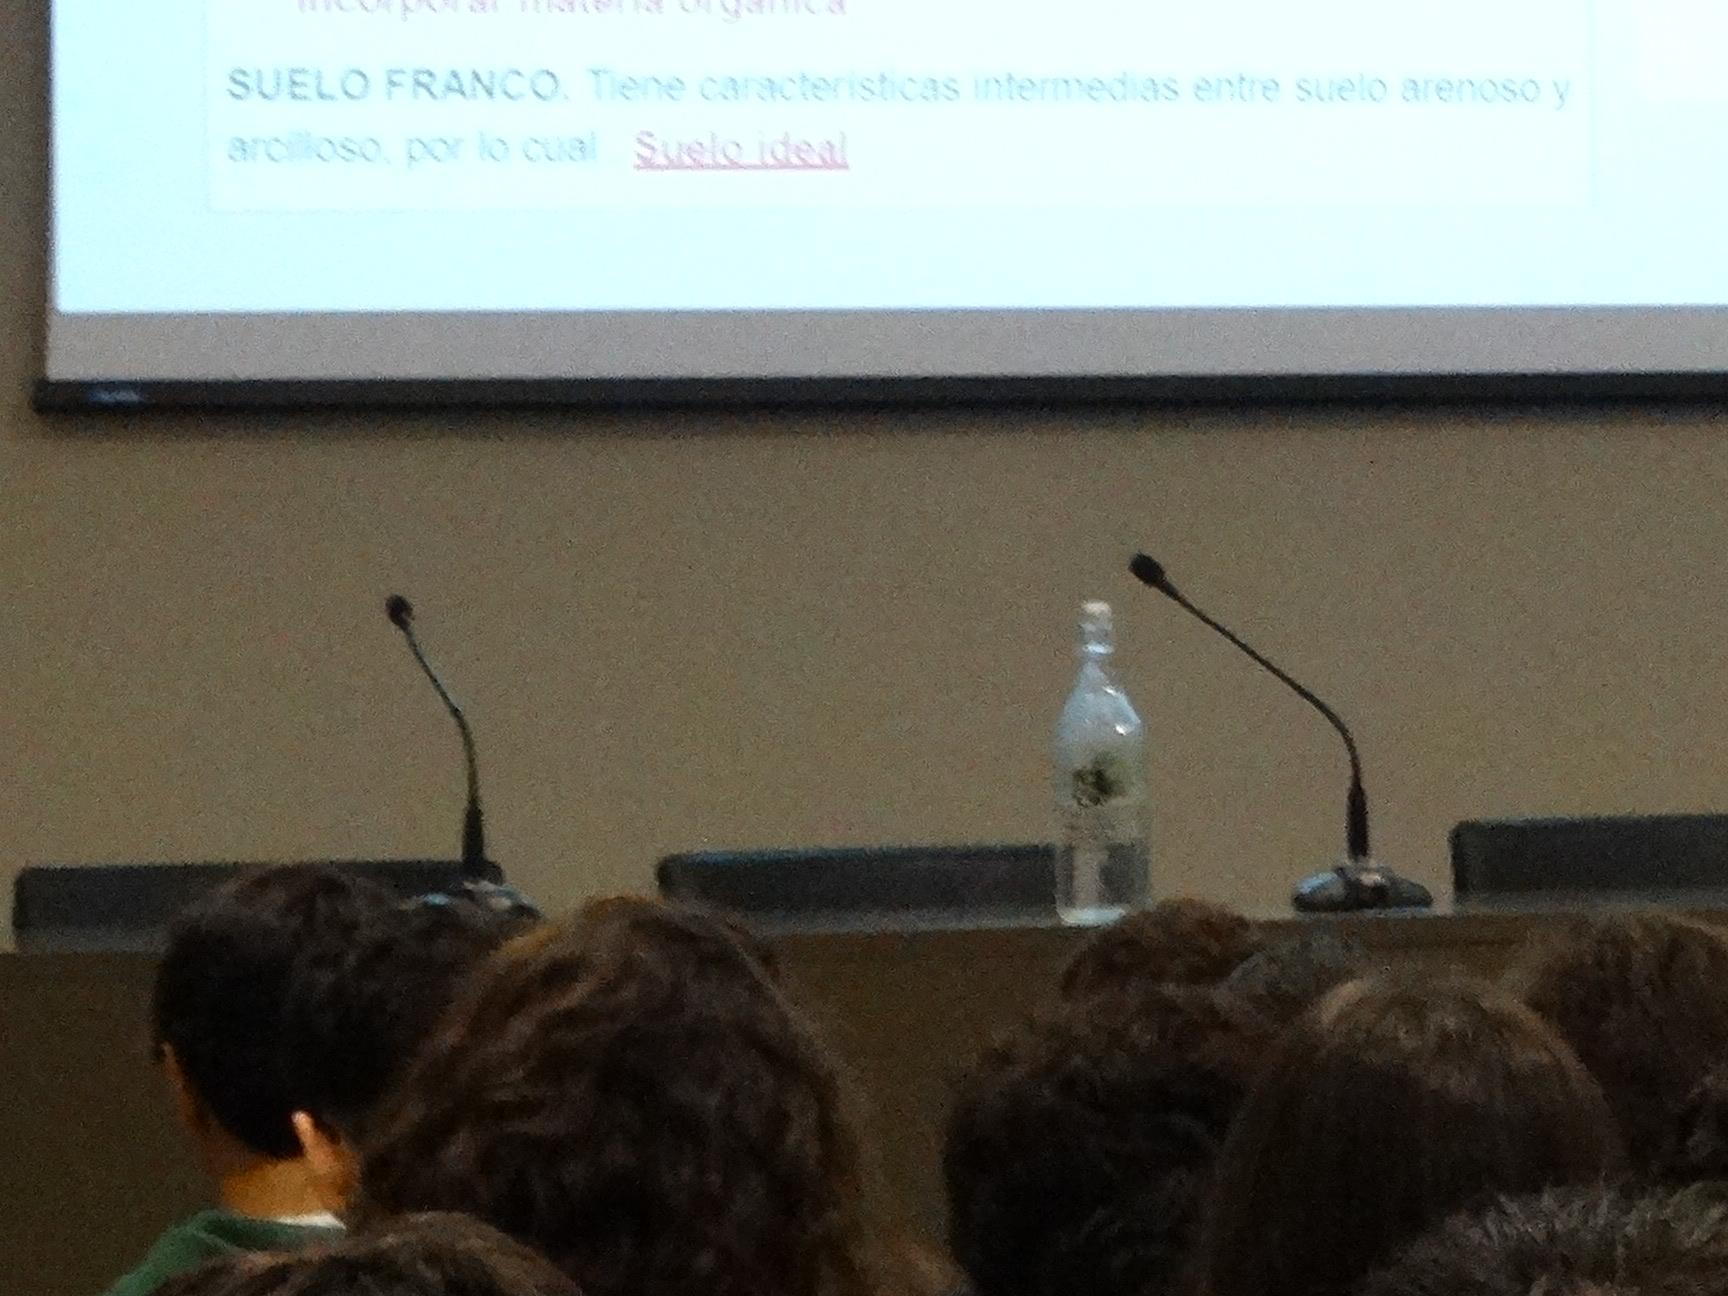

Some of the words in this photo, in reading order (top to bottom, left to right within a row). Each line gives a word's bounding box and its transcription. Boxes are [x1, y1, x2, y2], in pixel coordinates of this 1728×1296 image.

[226, 66, 372, 103] SUELO
[586, 65, 688, 103] Tiene
[973, 71, 1181, 104] intermedias
[1191, 71, 1281, 103] entre
[1295, 72, 1389, 104] suelo
[1400, 76, 1542, 105] arenoso
[1551, 79, 1572, 112] y
[405, 136, 465, 170] por
[476, 130, 511, 163] lo
[634, 128, 746, 162] Suelo
[759, 130, 848, 162] ideal
